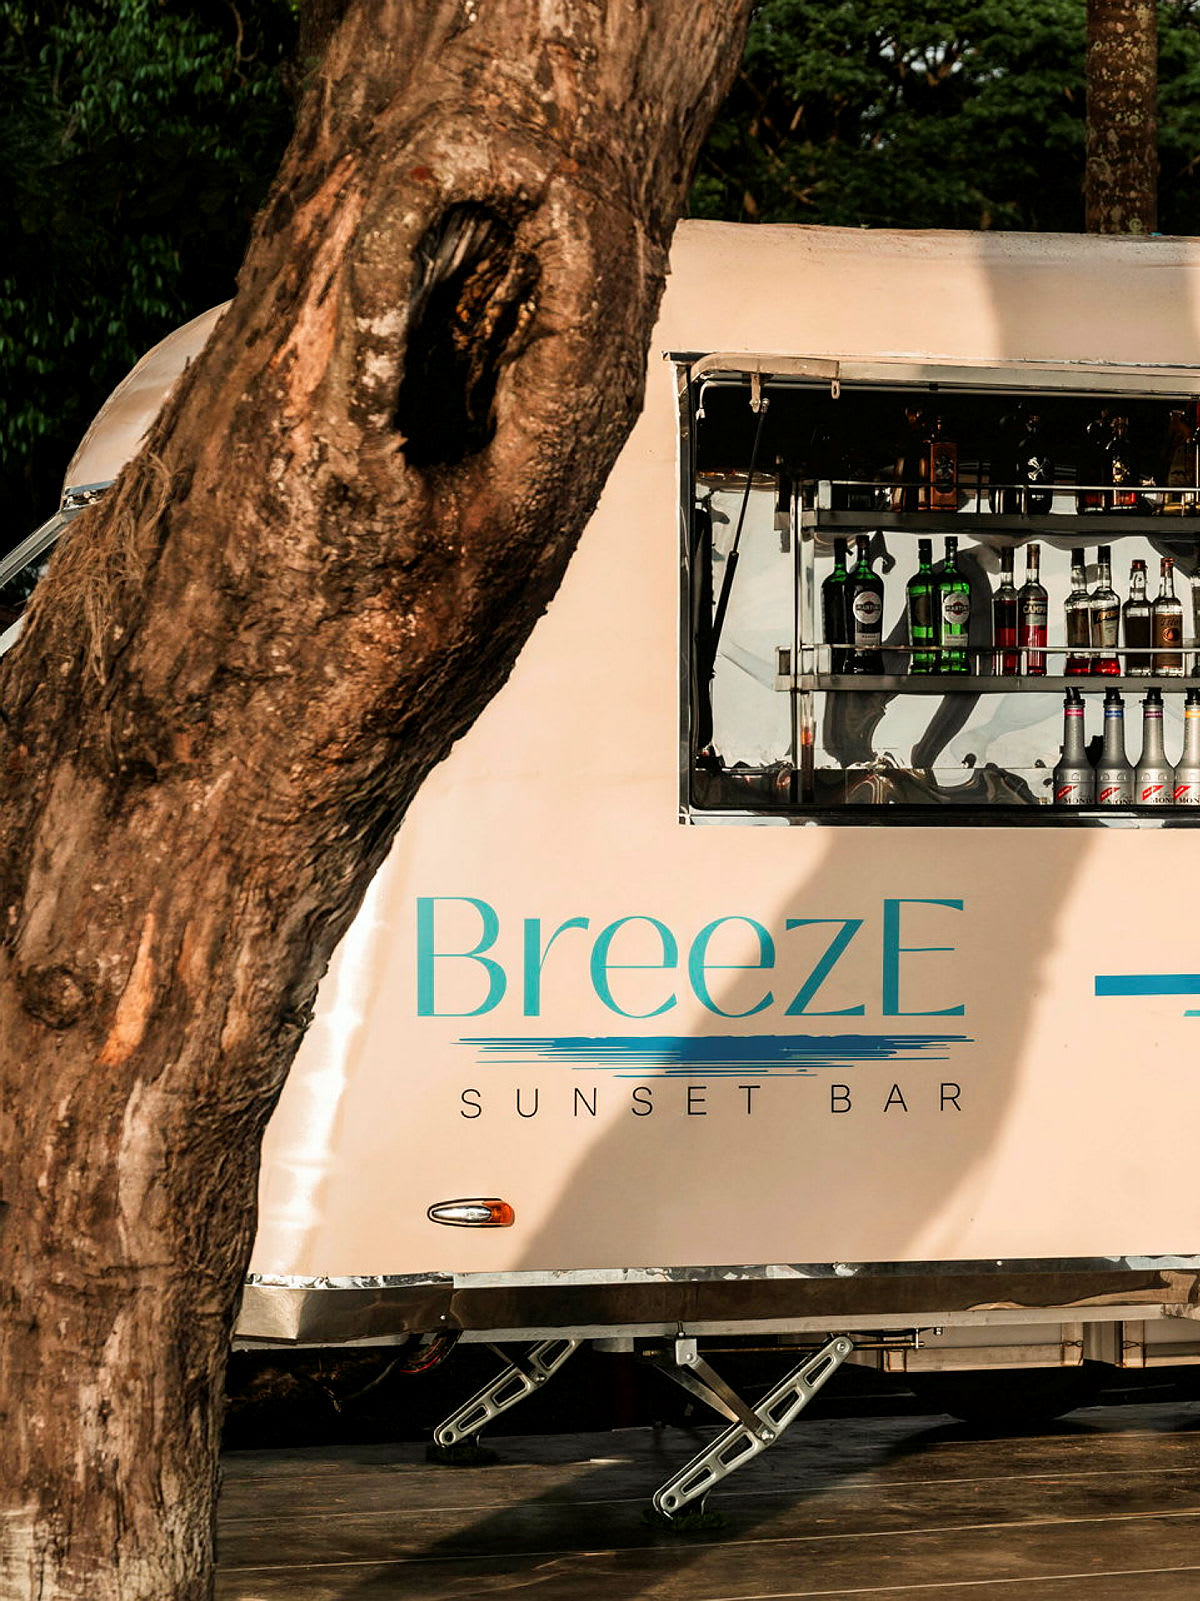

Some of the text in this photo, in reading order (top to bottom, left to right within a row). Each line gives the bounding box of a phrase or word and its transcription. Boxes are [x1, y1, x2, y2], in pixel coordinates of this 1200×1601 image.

[416, 896, 965, 1019] BreezE
[459, 1082, 963, 1119] SUNSET BAR
